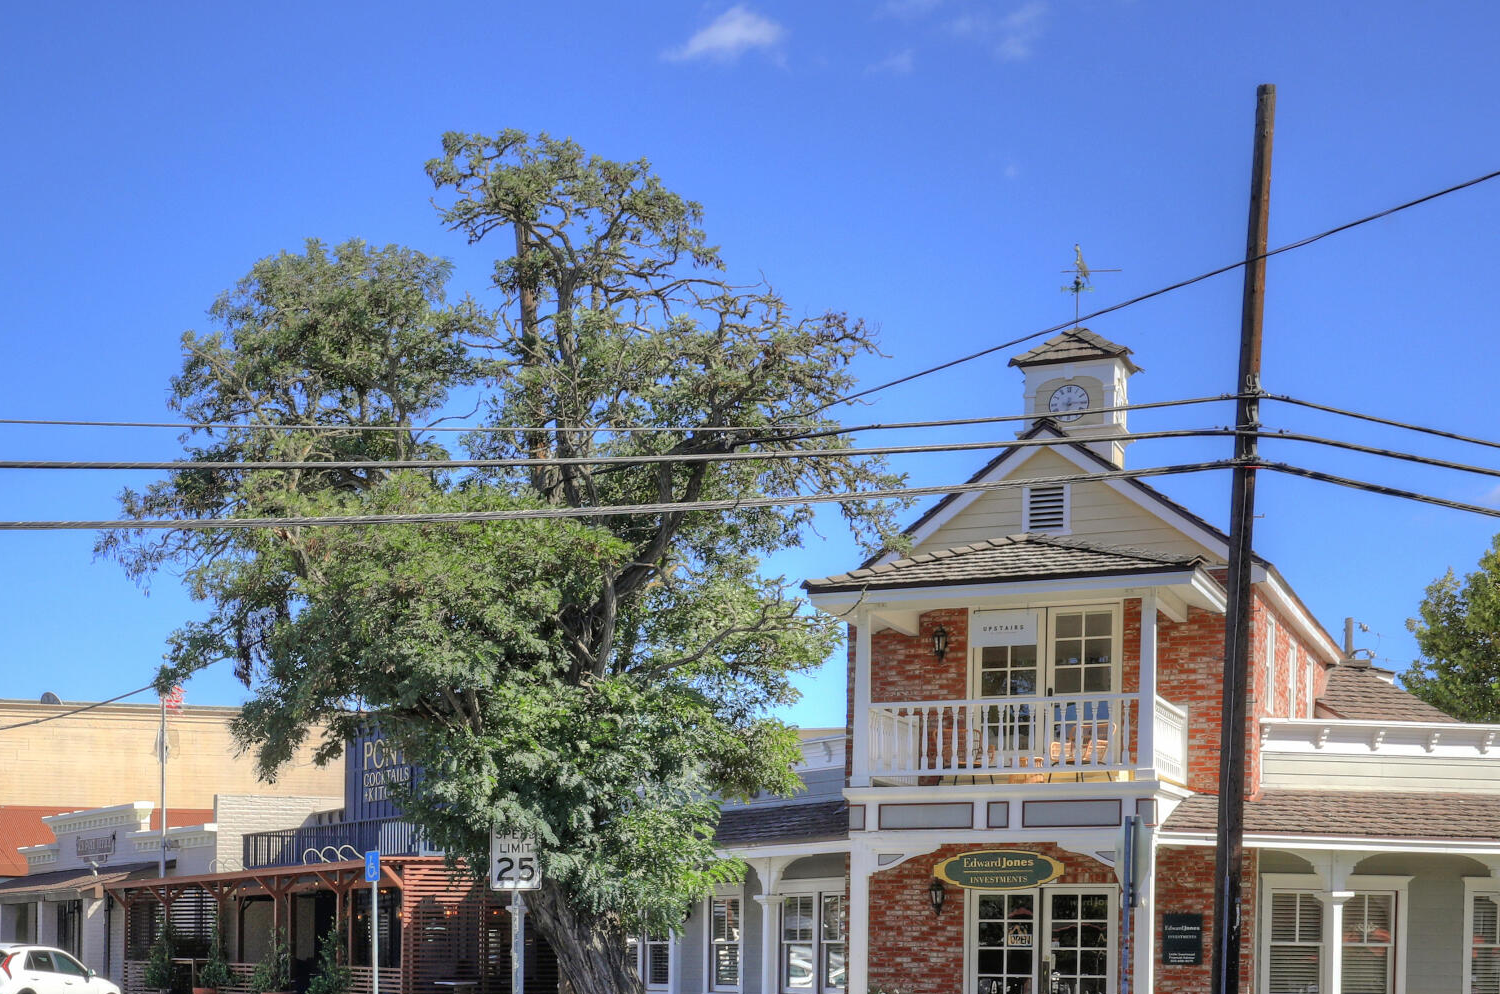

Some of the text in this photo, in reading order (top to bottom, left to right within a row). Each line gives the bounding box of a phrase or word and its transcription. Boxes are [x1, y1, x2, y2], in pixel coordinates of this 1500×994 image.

[982, 624, 1025, 632] UPSTAIRS
[363, 767, 410, 787] COCKTAILS
[496, 829, 536, 840] SPED
[499, 843, 532, 854] LIMIT
[496, 857, 535, 882] 25
[970, 875, 1028, 884] INVESTMENTS
[1010, 934, 1031, 945] OPEN
